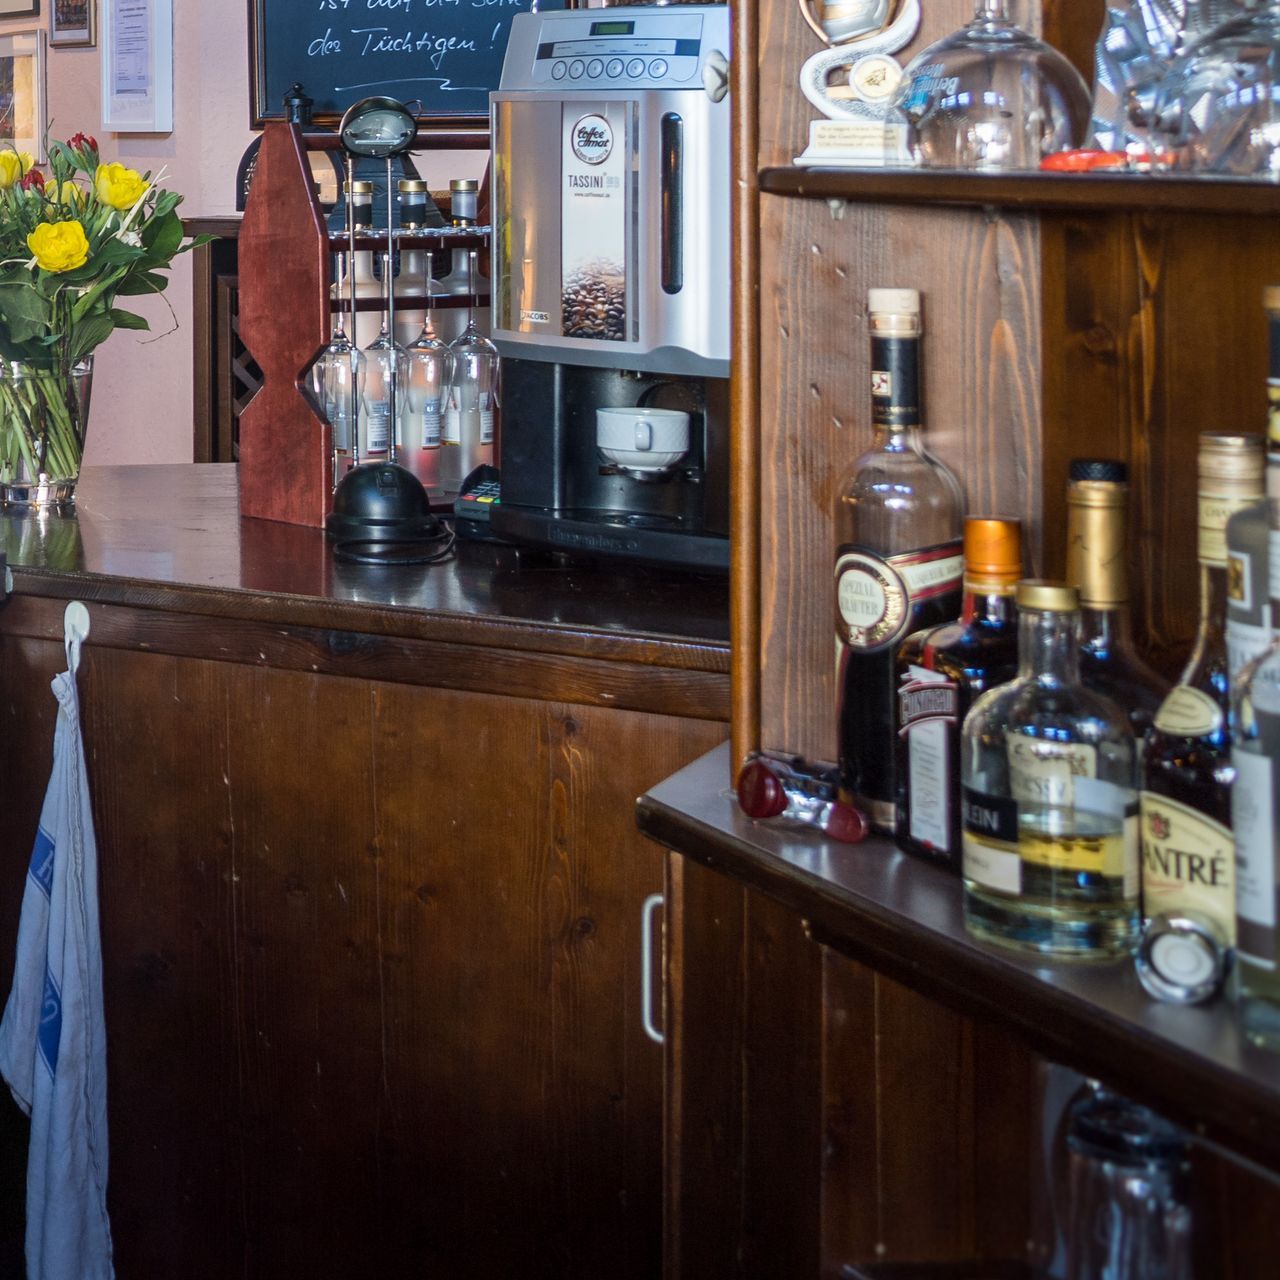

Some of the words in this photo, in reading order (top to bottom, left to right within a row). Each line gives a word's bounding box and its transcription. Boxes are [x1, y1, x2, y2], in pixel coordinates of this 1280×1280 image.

[351, 27, 476, 70] Tüchtigen
[577, 126, 606, 140] Coffee
[568, 175, 603, 188] TASSINI
[1143, 842, 1229, 888] ANTRÉ
